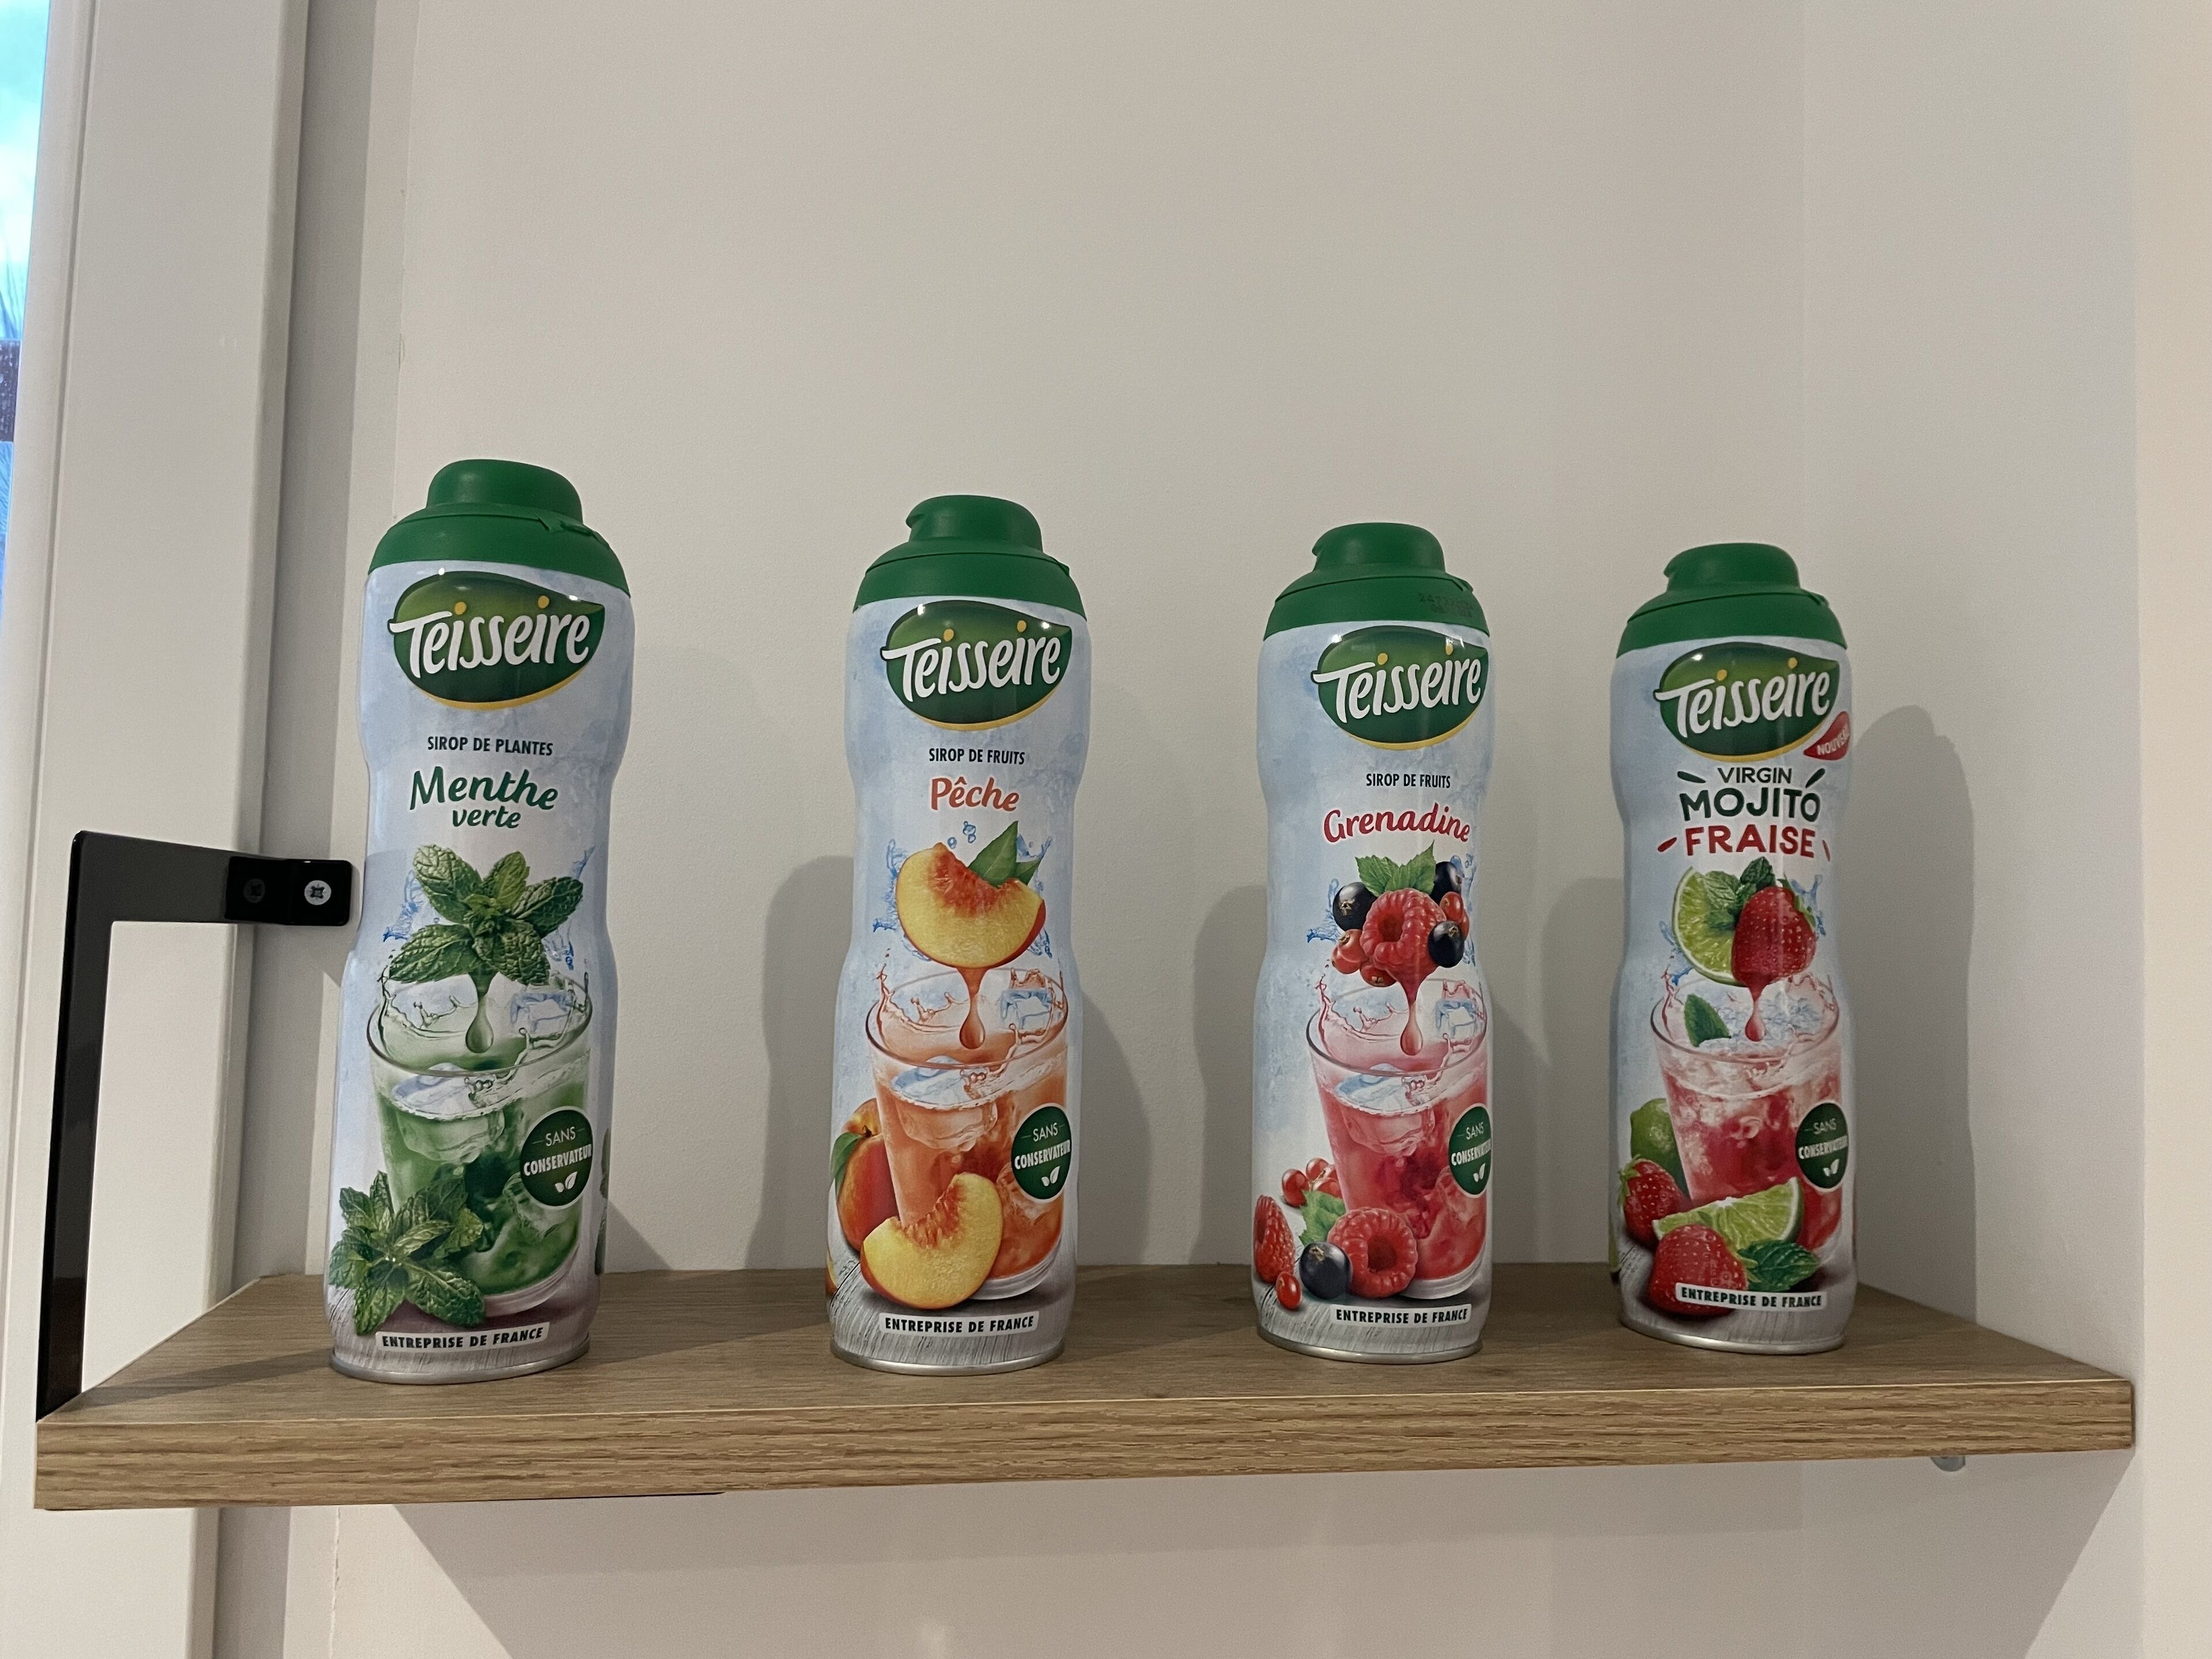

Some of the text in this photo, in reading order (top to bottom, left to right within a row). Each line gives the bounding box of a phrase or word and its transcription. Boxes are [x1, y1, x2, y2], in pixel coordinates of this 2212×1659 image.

[389, 594, 590, 679] Teisseire
[881, 619, 1061, 702] Teisseire
[1313, 637, 1482, 724] Teisseire
[1655, 657, 1831, 738] Teisseire
[427, 736, 554, 756] SIROP DE PLANTES
[929, 748, 1025, 766] SIROP DE FRUITS
[1366, 772, 1451, 789] SIROP DE FRUITS
[1717, 767, 1793, 784] VIRGIN
[409, 766, 559, 810] Menthe
[930, 776, 1020, 812] Pêche
[1679, 787, 1821, 823] MOJITO
[452, 805, 522, 830] verte
[1323, 802, 1471, 843] Grenadine
[1685, 824, 1816, 858] FRAISE
[546, 1126, 576, 1147] SANS
[1033, 1122, 1058, 1142] SANS
[1465, 1121, 1484, 1140] SANS
[1813, 1118, 1837, 1135] SANS
[523, 1143, 592, 1176] CONSERVATEUR
[1014, 1139, 1071, 1170] CONSERVATEUR
[1681, 1287, 1822, 1308] ENTREPRISE DE FRANCE
[885, 1315, 1035, 1334] ENTREPRISE DE FRANCE
[1336, 1308, 1468, 1324] ENTREPRISE DE FRANCE
[382, 1327, 544, 1349] ENTREPRISE DE FRANCE
